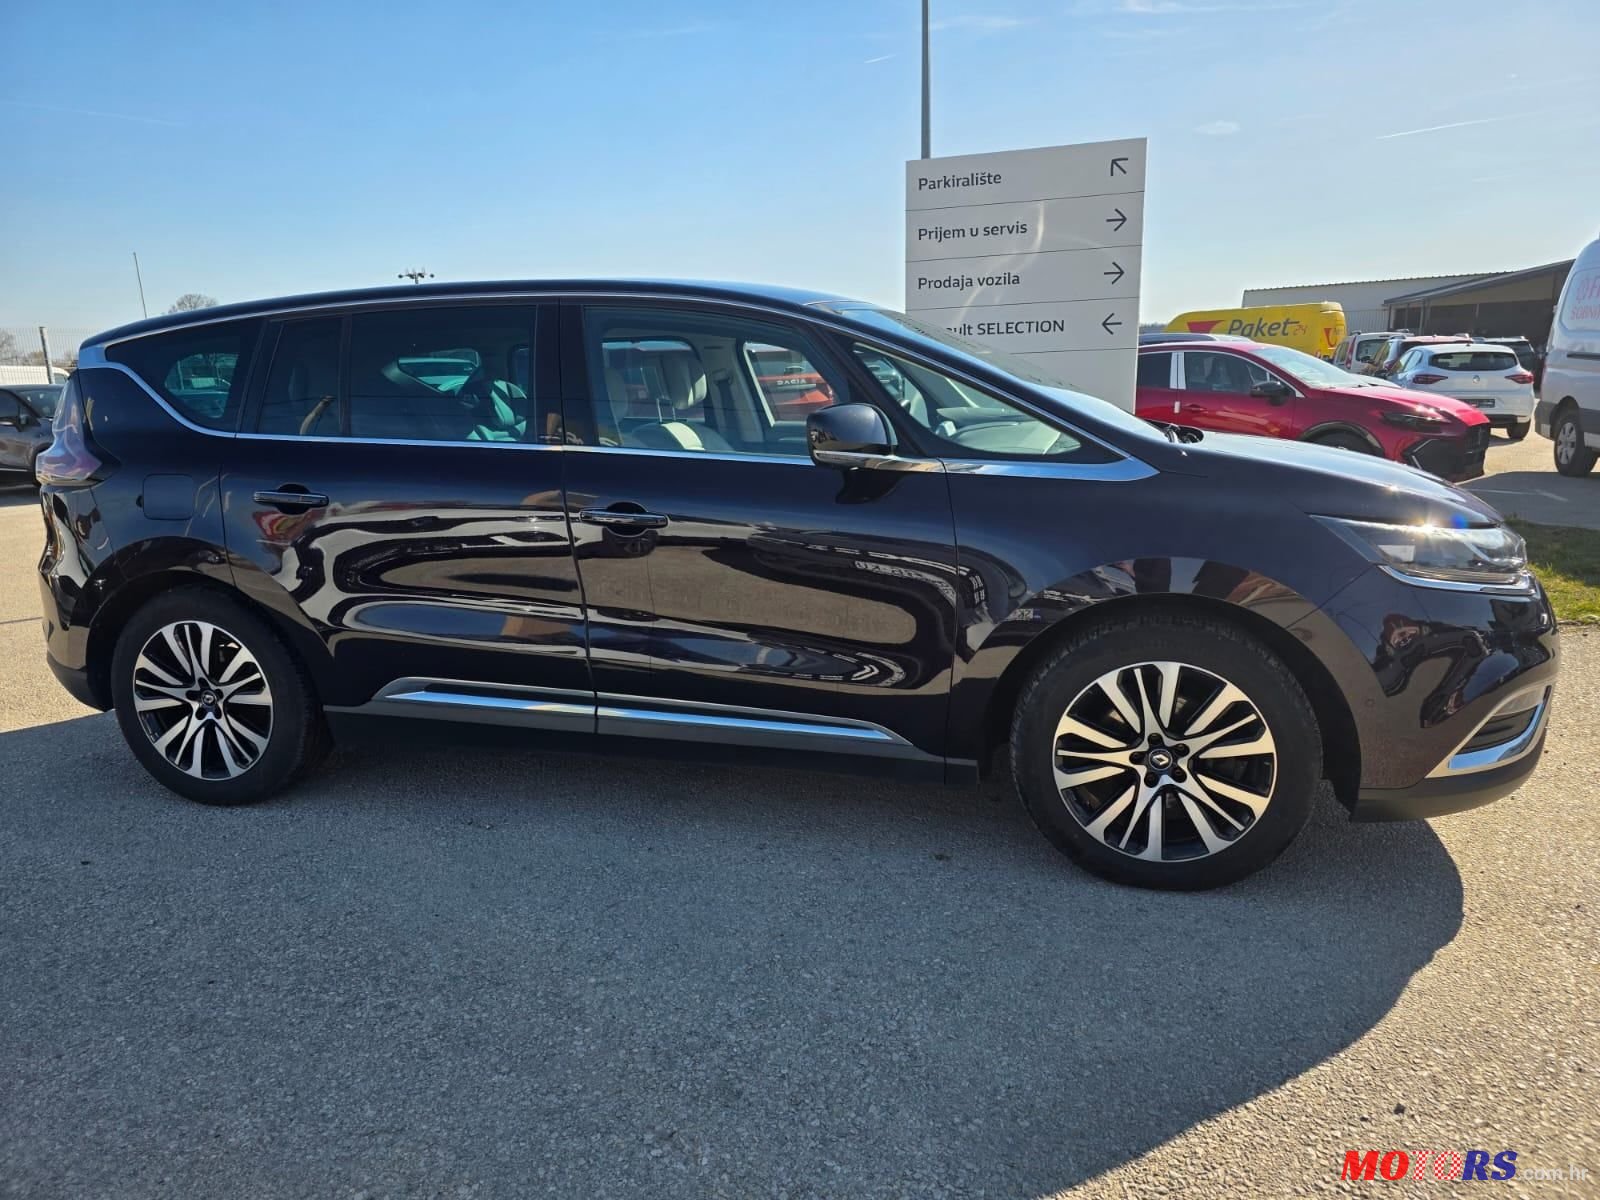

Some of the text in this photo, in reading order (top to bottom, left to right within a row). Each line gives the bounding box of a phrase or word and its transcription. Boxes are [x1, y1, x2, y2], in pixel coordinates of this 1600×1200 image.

[918, 171, 1002, 191] Parkiralište
[918, 221, 1028, 243] Prijem u servis
[918, 272, 1020, 291] Prodaja vozila
[977, 319, 1065, 335] SELECTION
[1228, 317, 1300, 338] Paket
